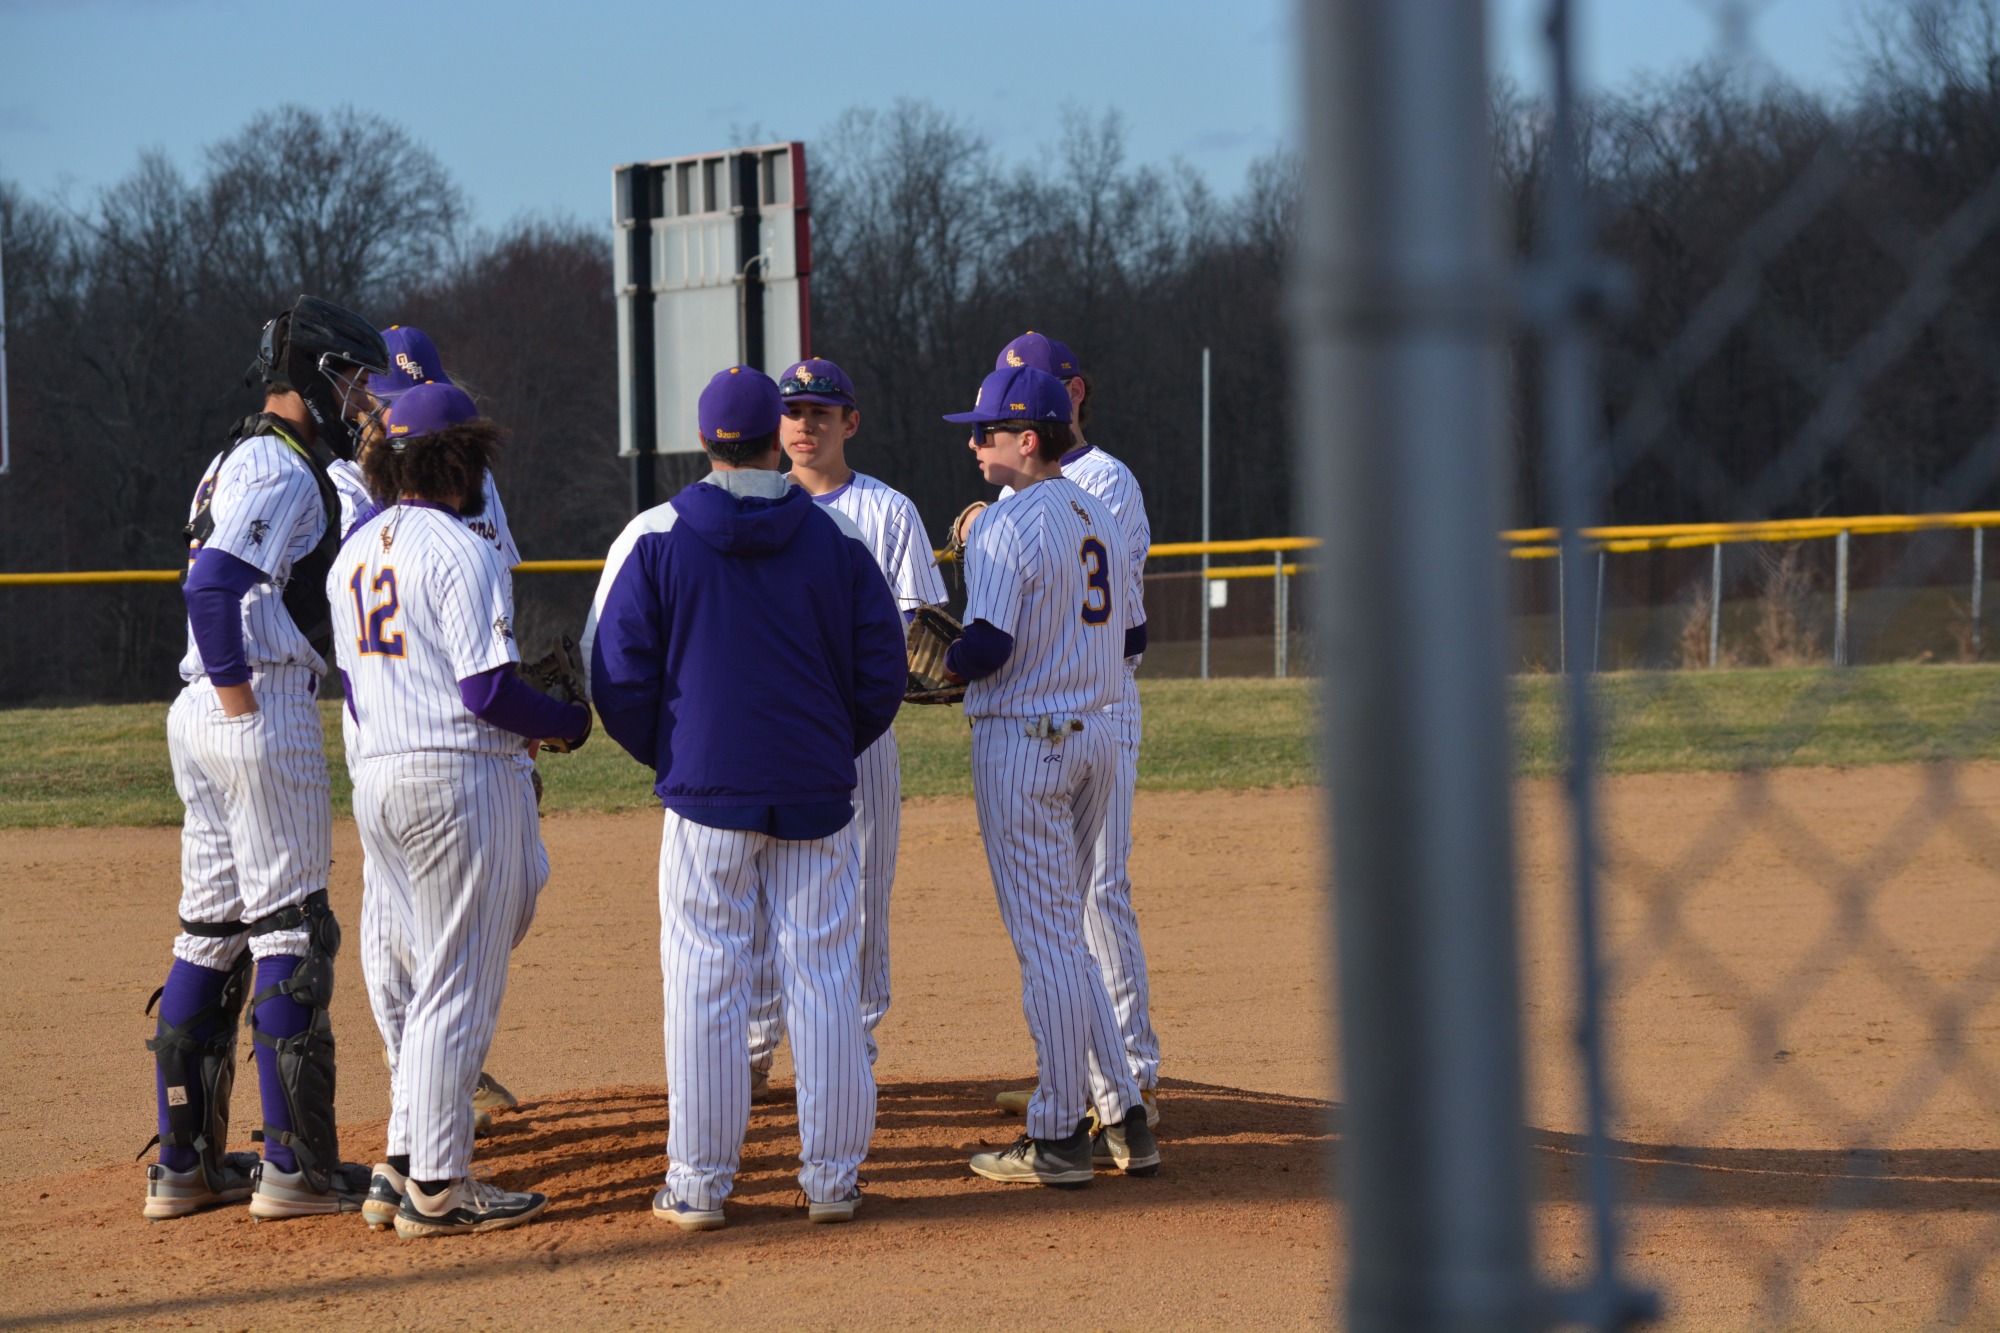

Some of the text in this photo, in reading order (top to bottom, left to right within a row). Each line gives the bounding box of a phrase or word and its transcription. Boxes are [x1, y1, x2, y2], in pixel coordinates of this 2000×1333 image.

[1010, 403, 1026, 411] TML
[350, 563, 407, 659] 12
[1080, 535, 1112, 627] 3
